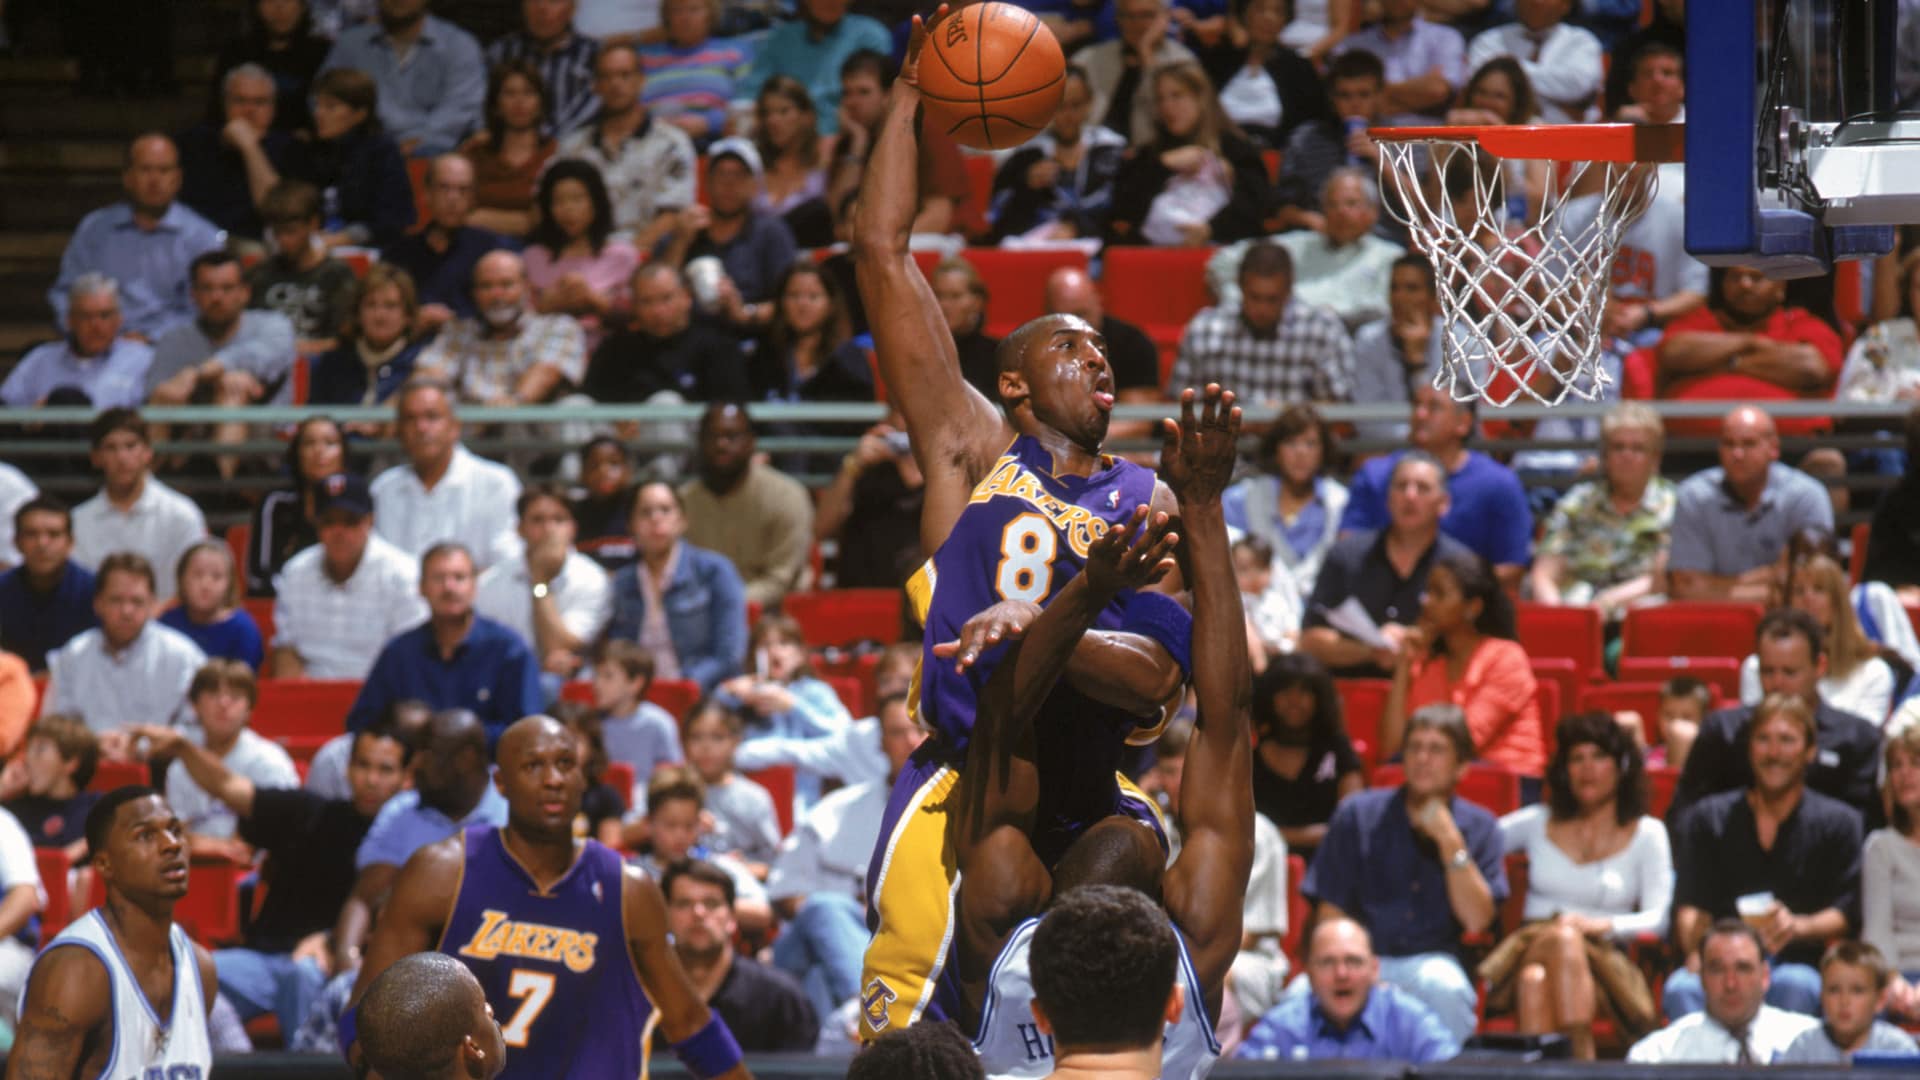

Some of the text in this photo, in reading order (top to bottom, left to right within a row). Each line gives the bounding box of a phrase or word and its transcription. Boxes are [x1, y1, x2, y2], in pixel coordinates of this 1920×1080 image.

[968, 453, 1110, 559] LAKERS
[995, 512, 1057, 605] 8
[458, 909, 598, 973] LAKERS
[500, 968, 557, 1048] 7
